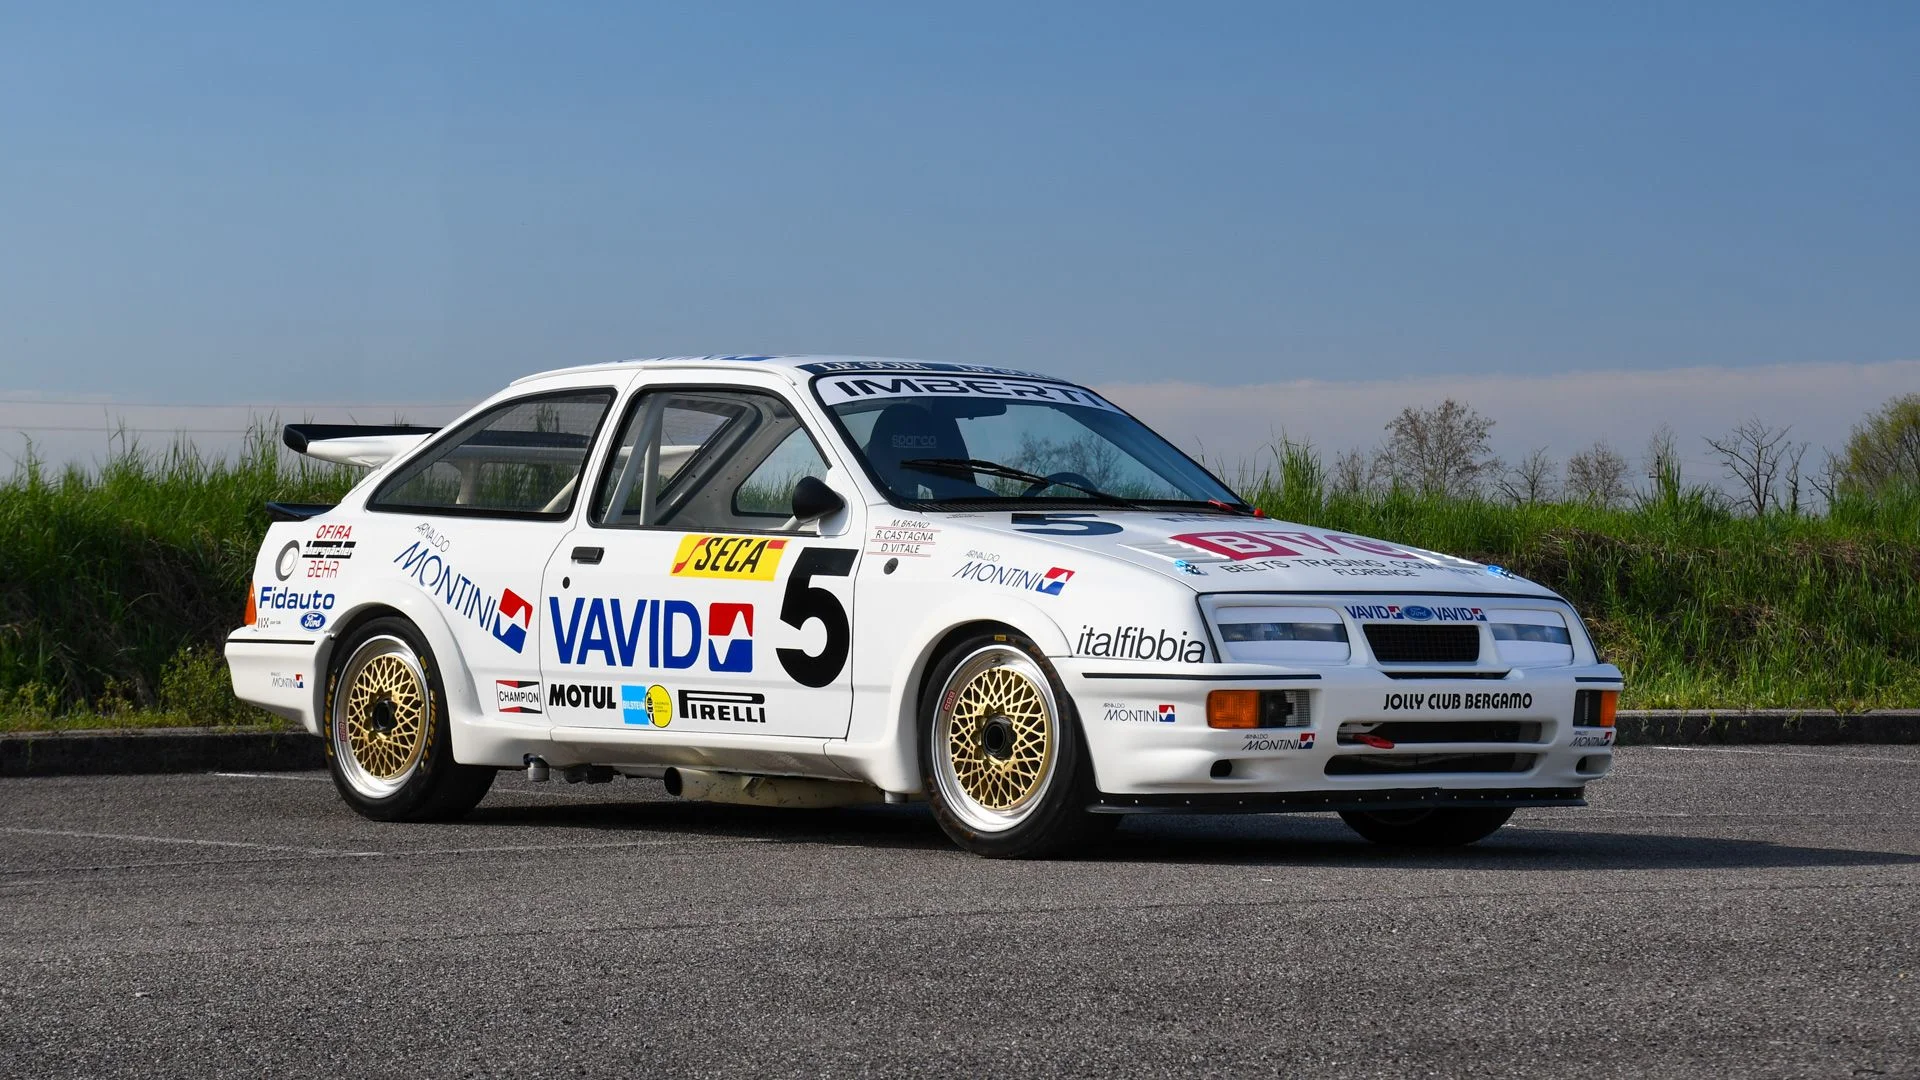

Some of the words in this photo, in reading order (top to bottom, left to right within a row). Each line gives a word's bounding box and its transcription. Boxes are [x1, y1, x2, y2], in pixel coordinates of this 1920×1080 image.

[834, 379, 1104, 408] IMBERTI
[892, 435, 937, 448] sparco
[316, 525, 352, 540] OFIRA
[1011, 513, 1124, 536] 5
[414, 522, 450, 553] ARNALDO
[694, 537, 770, 573] SECA
[965, 550, 1001, 562] ARNALDO
[307, 561, 340, 578] BEHR
[1219, 560, 1290, 573] BELTS
[1292, 559, 1386, 569] TRADING
[1333, 568, 1421, 577] FLORENCE
[952, 561, 1043, 590] MONTINI
[393, 541, 497, 631] MONTINI
[259, 587, 336, 610] Fidauto
[304, 613, 323, 627] Ford
[775, 547, 859, 688] 5
[1344, 605, 1391, 619] VAVID
[1431, 606, 1474, 620] VAVID
[549, 596, 701, 669] VAVID
[1076, 625, 1206, 663] italfibbia
[499, 690, 539, 703] CHAMPION
[548, 684, 616, 709] MOTUL
[1383, 694, 1424, 710] JOLLY
[1428, 694, 1461, 710] CLUB
[1464, 693, 1533, 709] BERGAMO
[677, 689, 766, 723] PIRELLI
[1104, 709, 1158, 722] MONTINI
[1241, 739, 1299, 750] MONTINI
